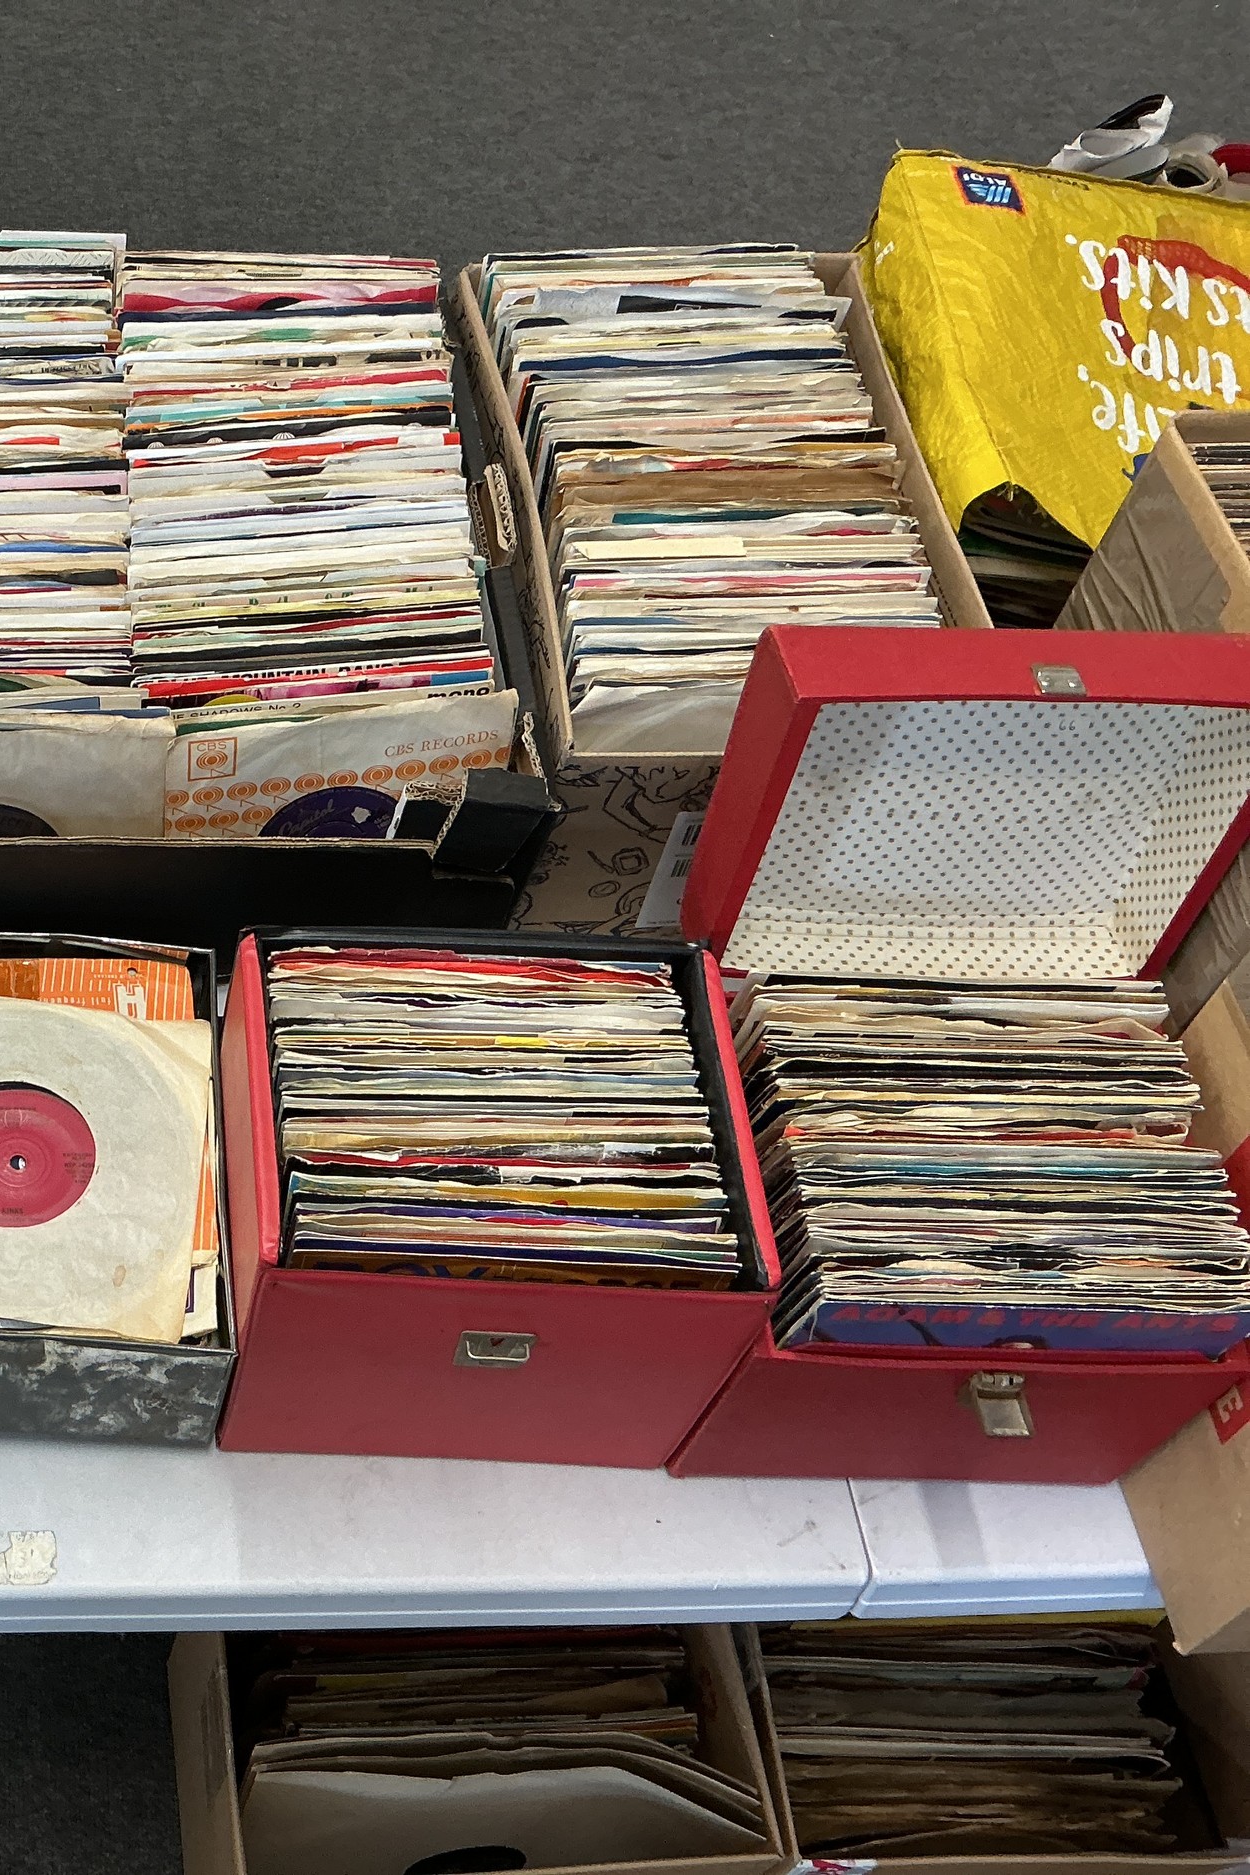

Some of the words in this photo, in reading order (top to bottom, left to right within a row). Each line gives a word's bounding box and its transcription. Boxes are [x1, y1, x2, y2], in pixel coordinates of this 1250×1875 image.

[962, 172, 1008, 187] ALDI
[1100, 318, 1242, 405] trips
[196, 740, 228, 751] CBS
[385, 743, 415, 759] CBS
[419, 729, 499, 753] RECORDS
[830, 1306, 974, 1323] ADAM
[1020, 1312, 1104, 1329] THE
[1111, 1314, 1240, 1332] ANTS
